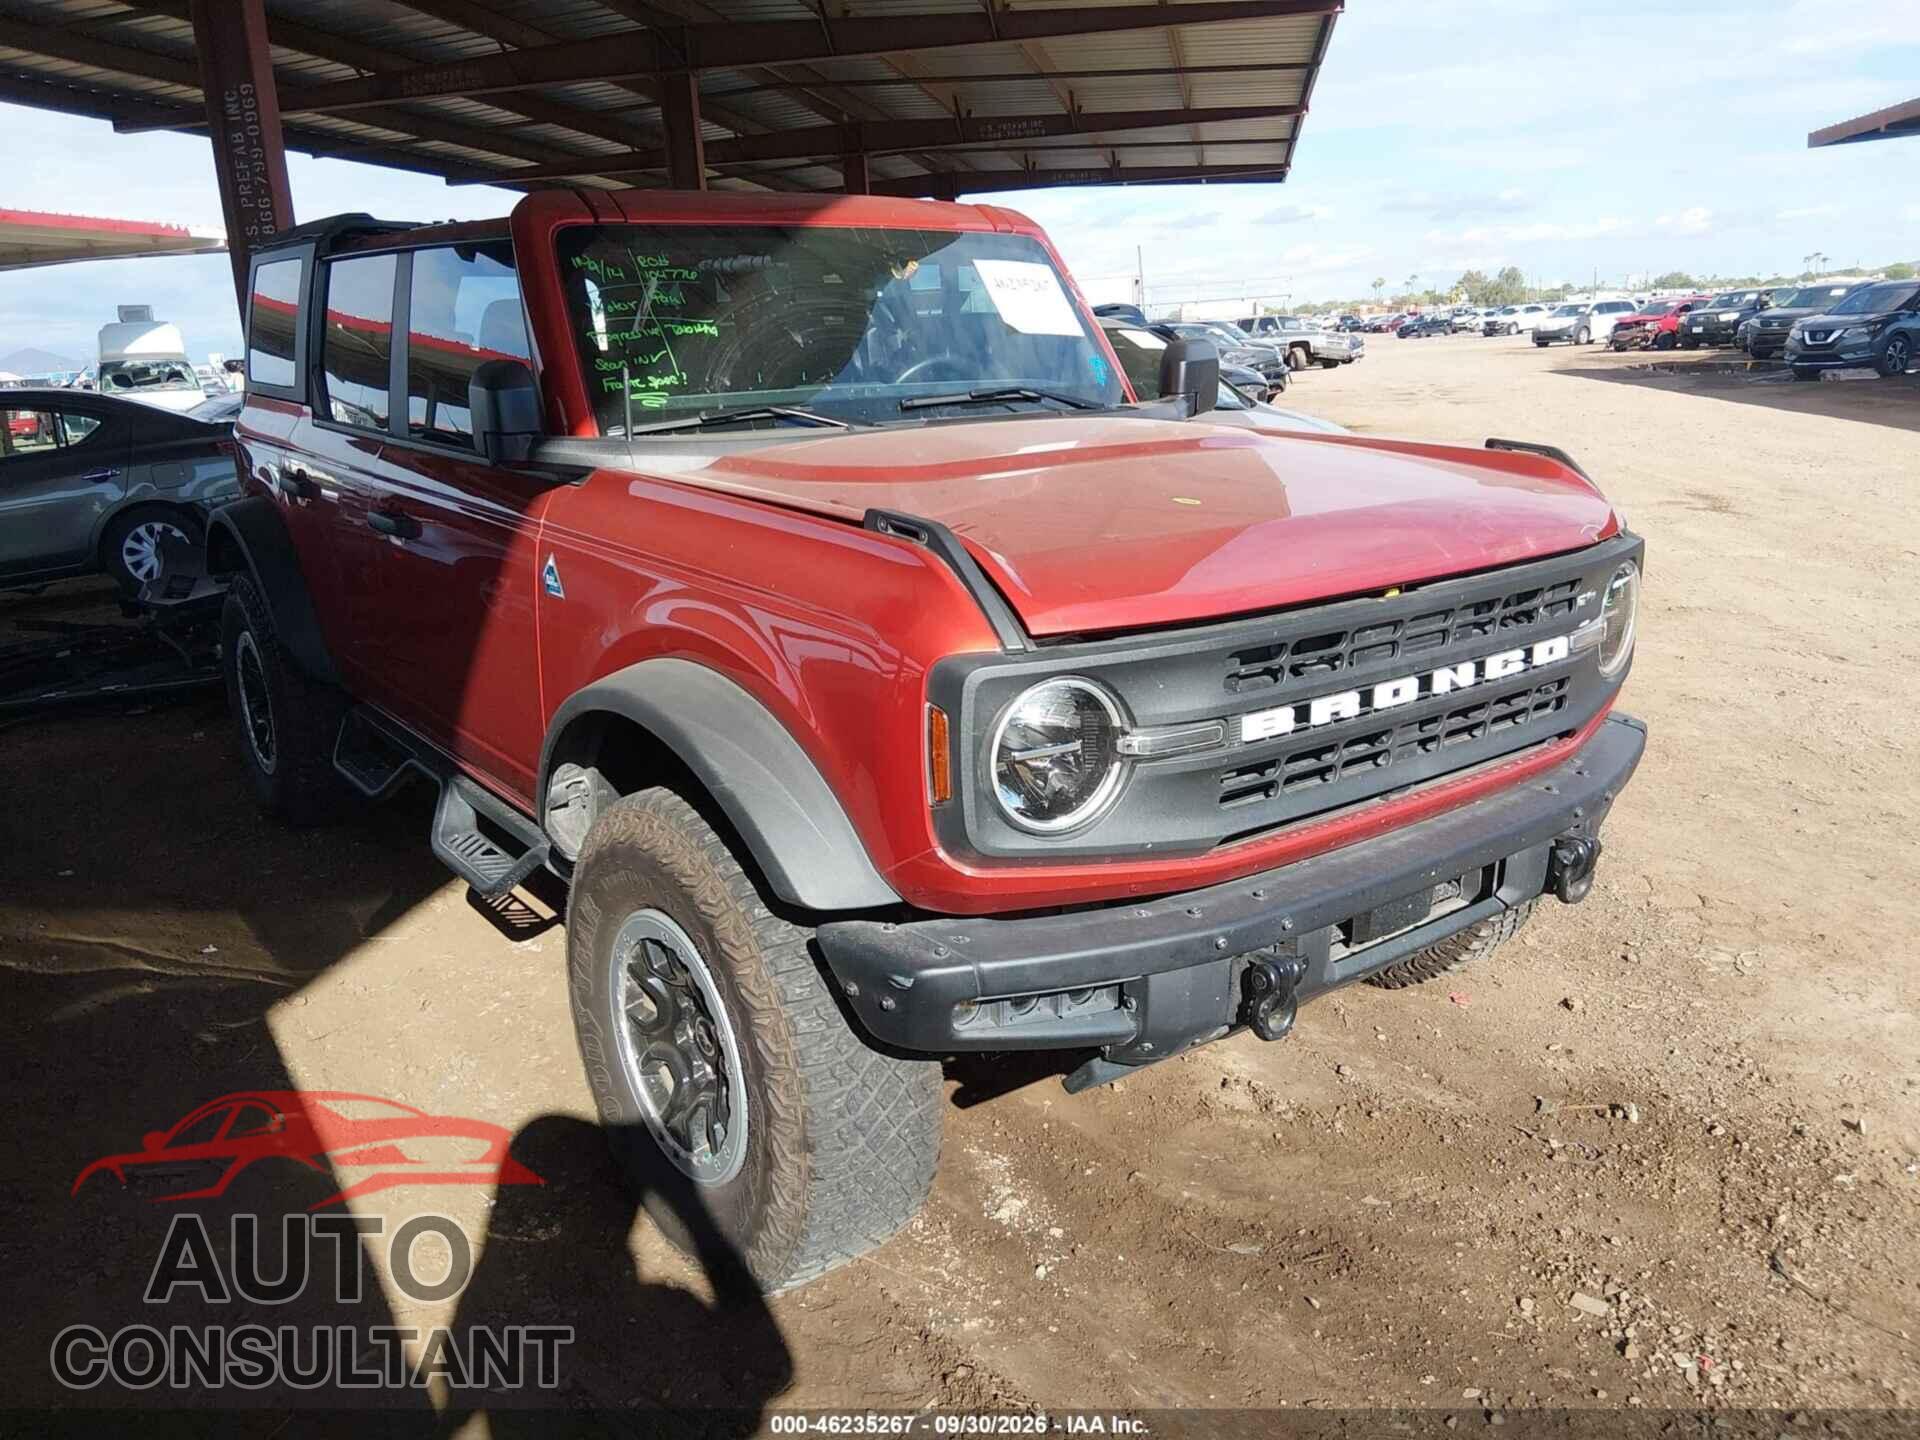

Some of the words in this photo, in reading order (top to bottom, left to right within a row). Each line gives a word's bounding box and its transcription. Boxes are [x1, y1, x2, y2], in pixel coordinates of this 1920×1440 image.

[231, 131, 255, 209] PREFAB
[239, 83, 276, 236] 866-799-0969
[1241, 636, 1569, 742] BRONCO
